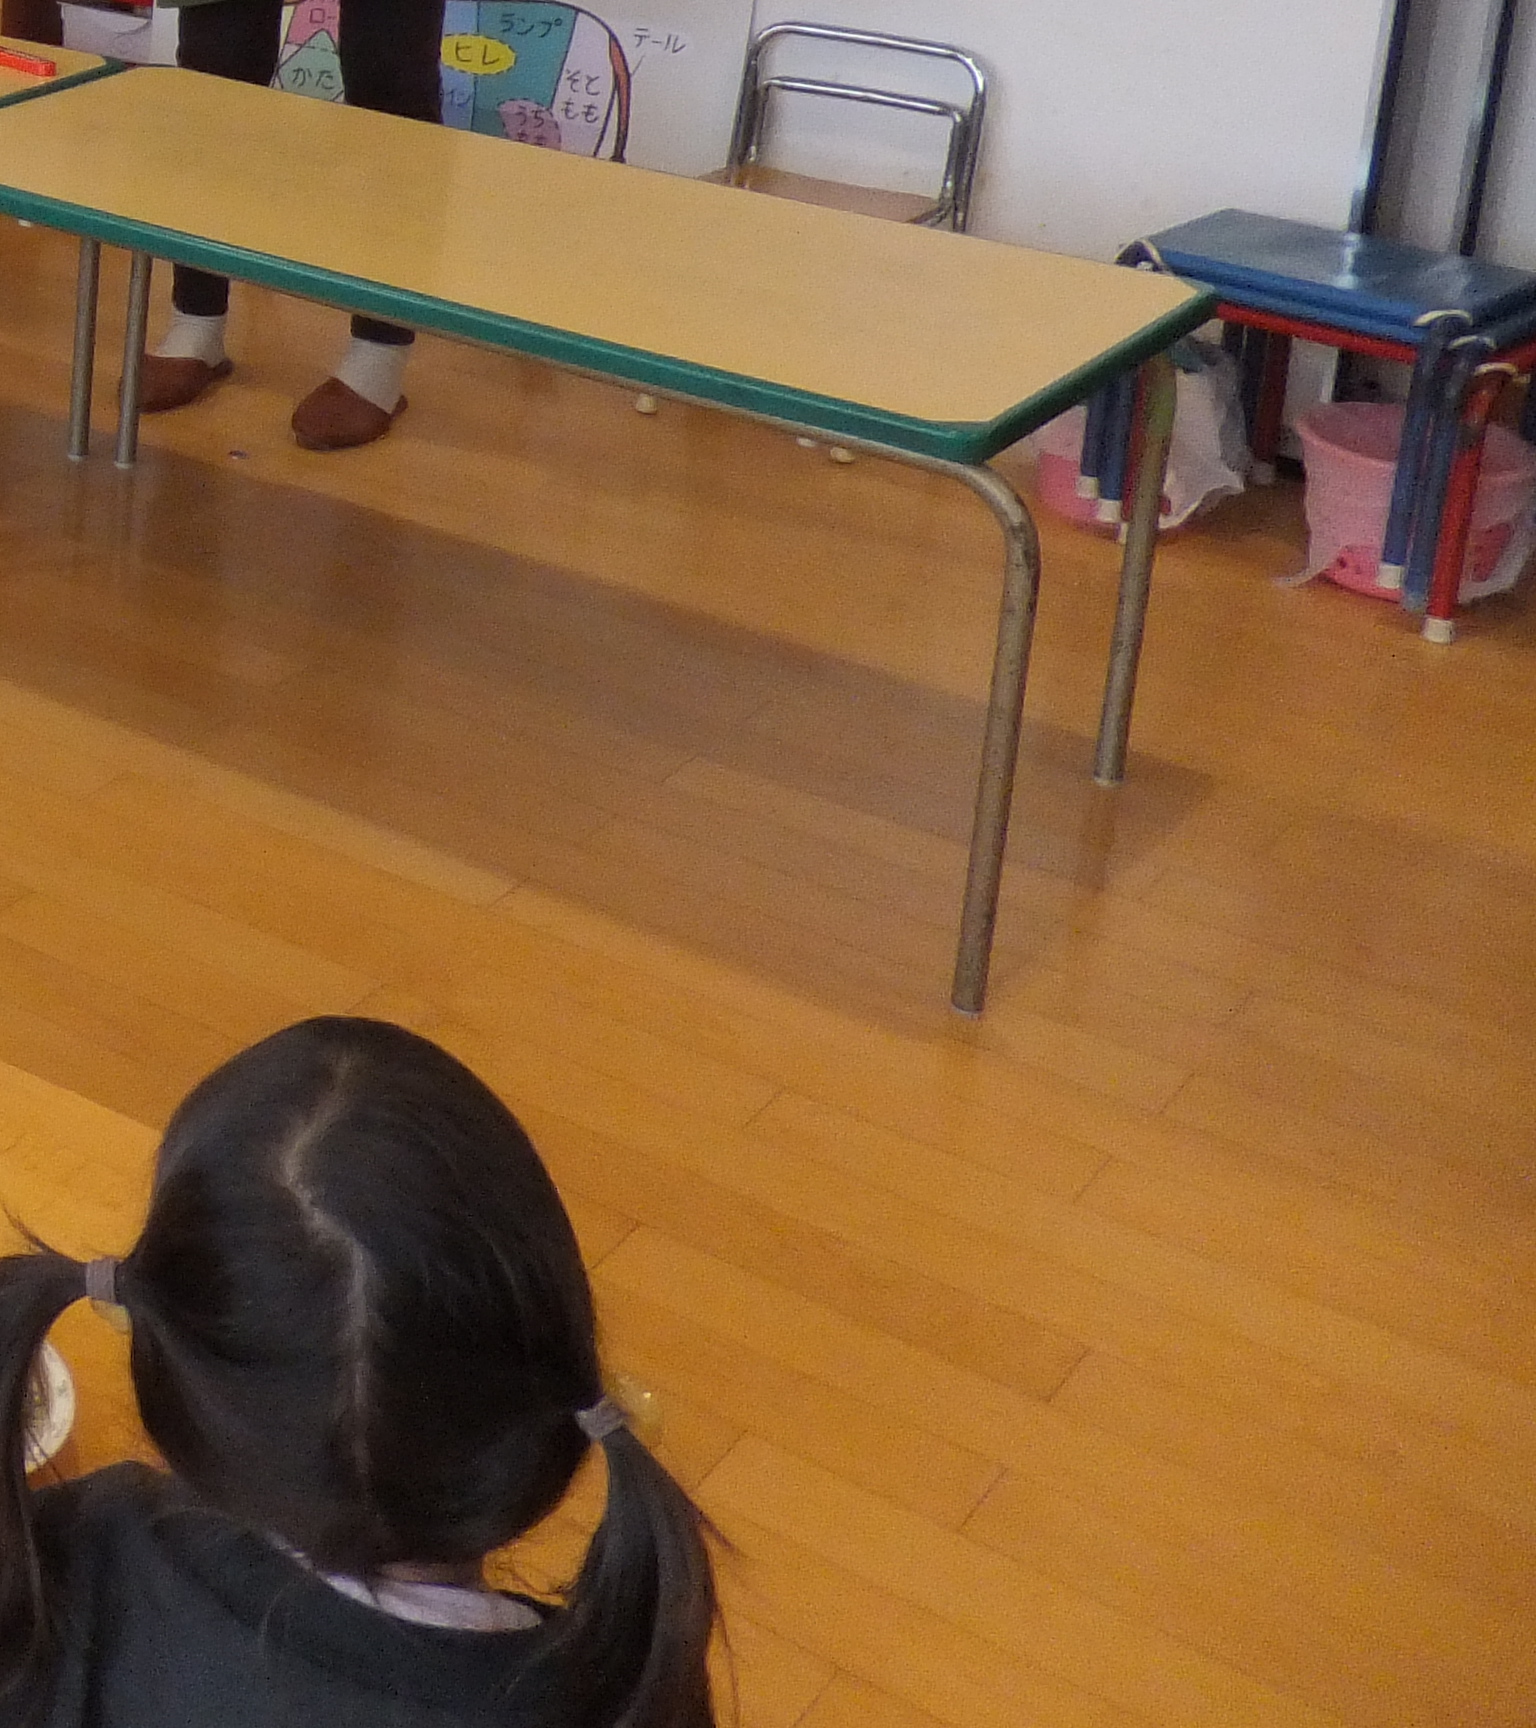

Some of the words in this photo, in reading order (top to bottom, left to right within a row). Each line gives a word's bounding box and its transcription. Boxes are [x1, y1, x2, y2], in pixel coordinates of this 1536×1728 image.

[500, 12, 563, 39] ランプ
[633, 26, 687, 55] テール
[454, 41, 500, 66] ヒレ
[292, 67, 334, 90] かた
[565, 68, 601, 96] そと
[515, 105, 545, 129] うち
[562, 100, 599, 124] もも
